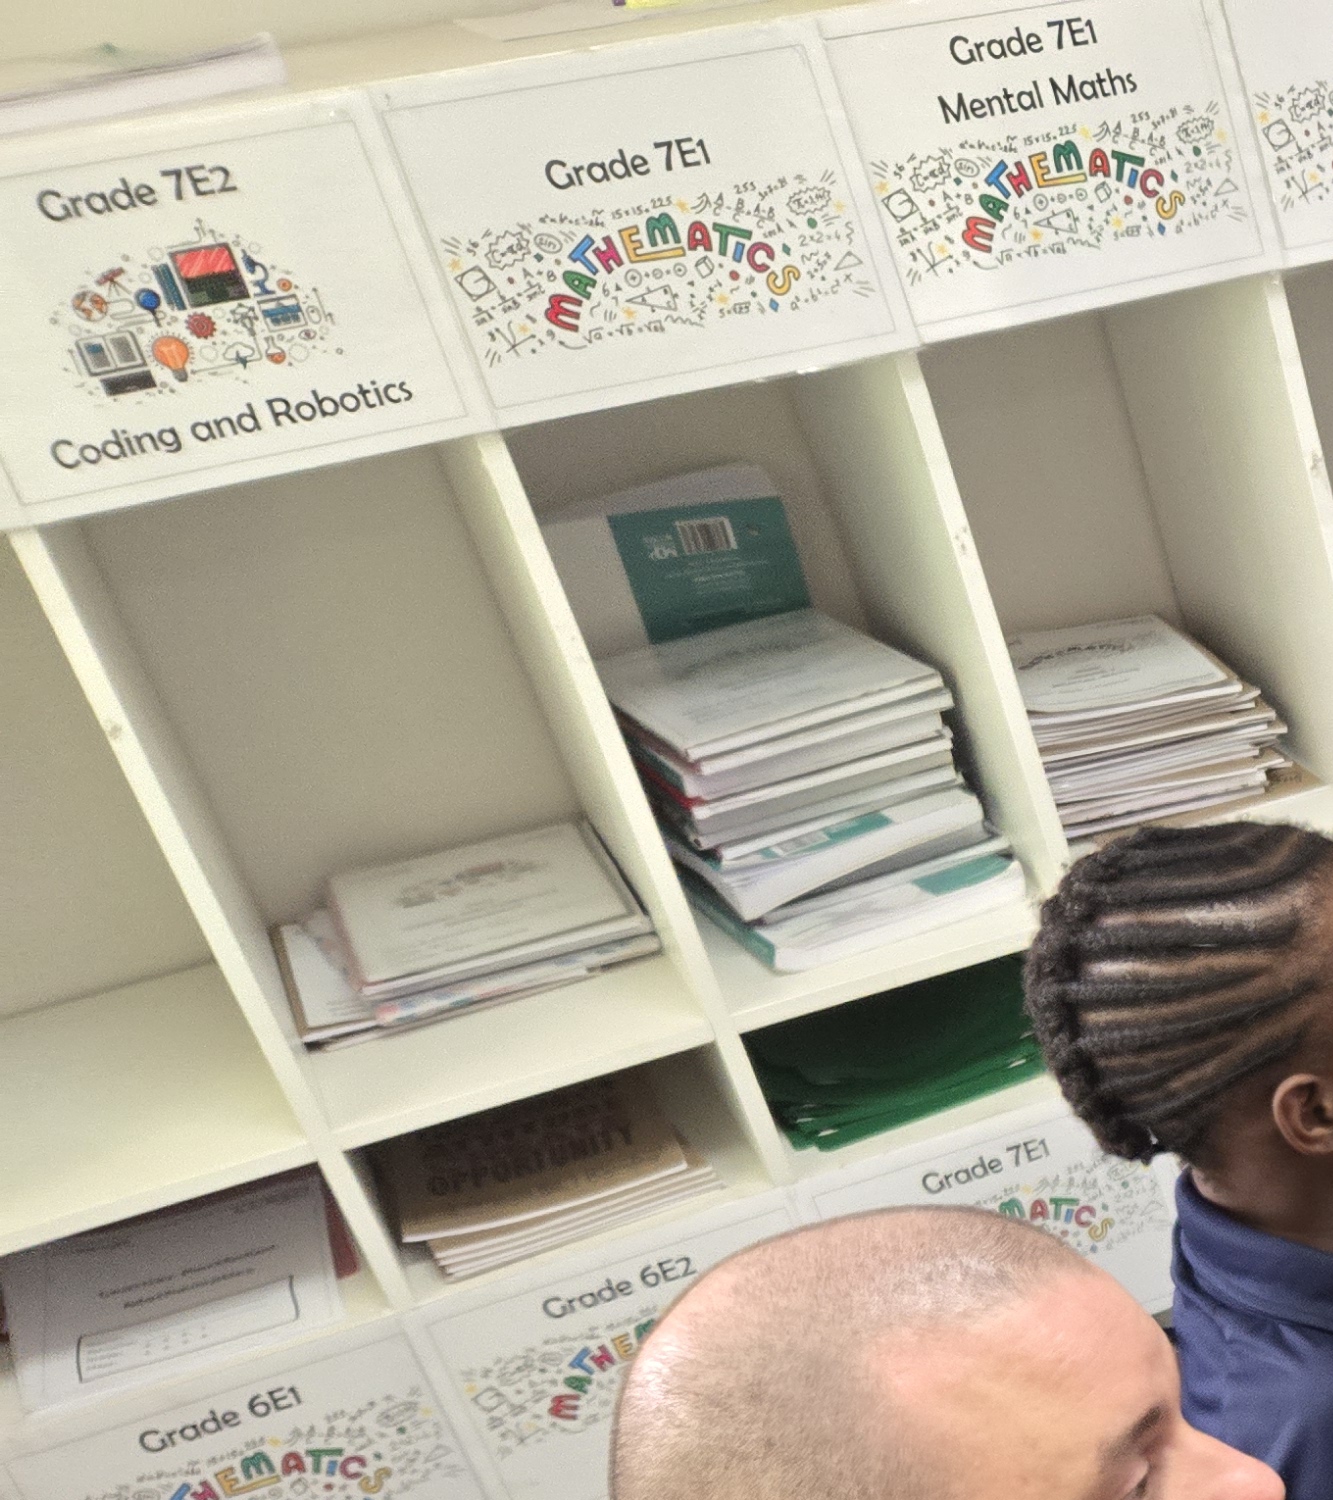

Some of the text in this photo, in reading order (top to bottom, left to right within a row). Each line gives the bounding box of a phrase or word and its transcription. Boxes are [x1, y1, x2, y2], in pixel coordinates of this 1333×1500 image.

[949, 17, 1098, 65] Grade 7E1
[938, 67, 1138, 124] Mental Maths
[36, 164, 238, 222] Grade 7E2
[544, 137, 711, 190] Grade 7E1
[961, 140, 1186, 253] MATHEMATICS
[544, 212, 801, 332] MATHEMATICS
[50, 374, 414, 470] Coding and Robotics
[921, 1138, 1051, 1195] Grade 7E1
[542, 1256, 698, 1319] Grade 6E2
[138, 1385, 303, 1453] Grade 6E1
